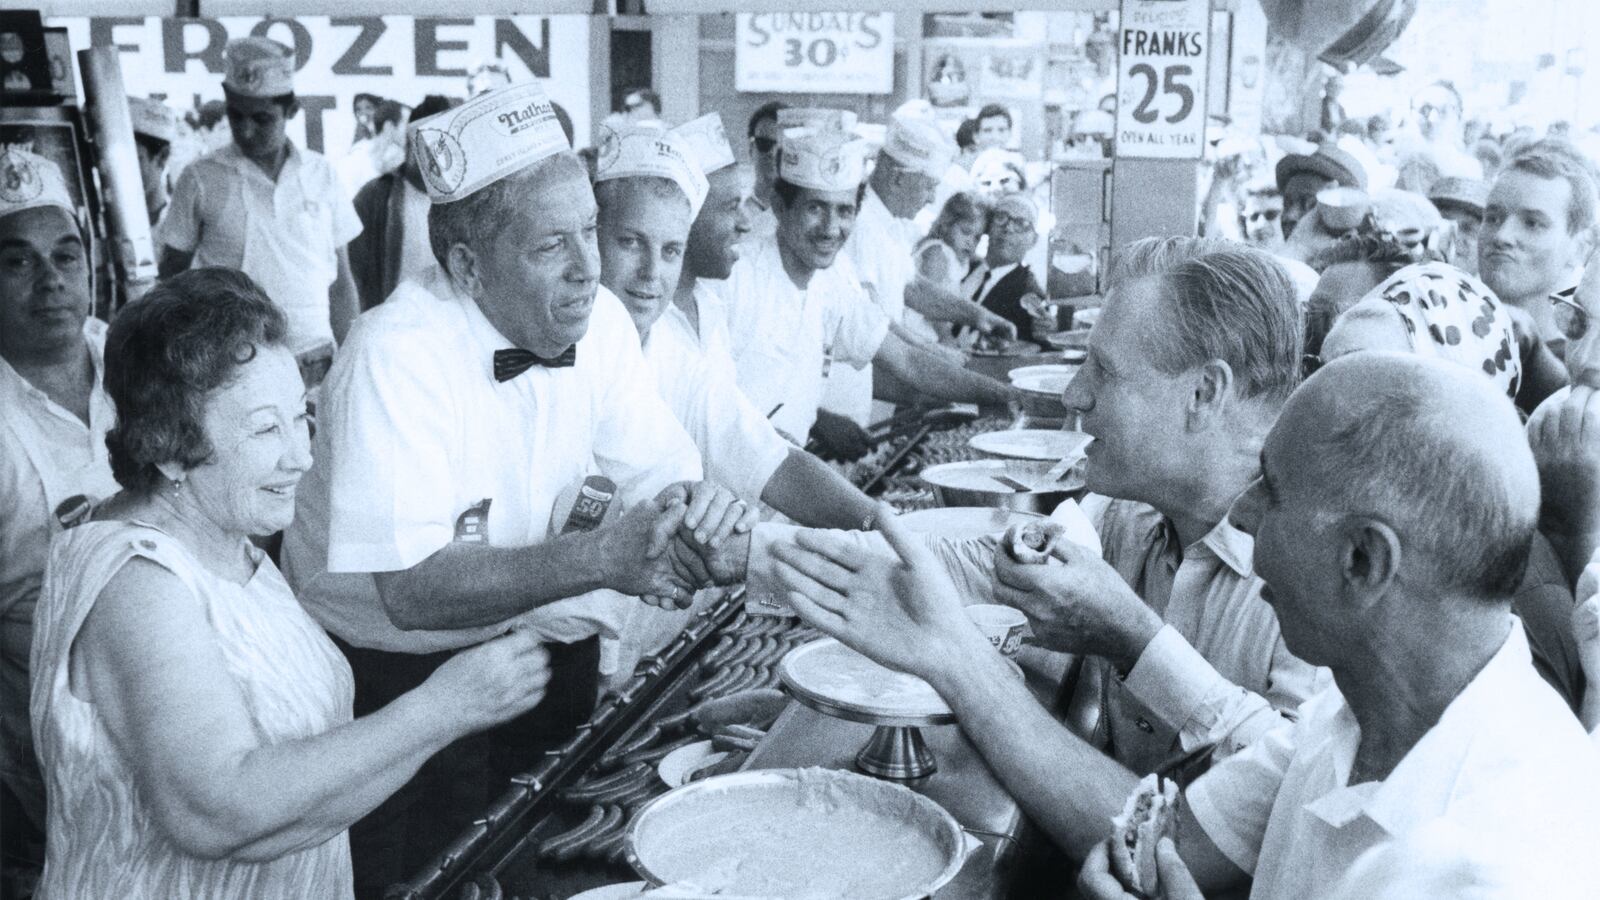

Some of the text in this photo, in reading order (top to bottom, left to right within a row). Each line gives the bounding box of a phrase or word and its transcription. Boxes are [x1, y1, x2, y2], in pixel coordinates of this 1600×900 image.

[89, 17, 552, 78] FROZEN
[1123, 29, 1203, 57] FRANKS
[1128, 63, 1195, 124] 25
[1121, 130, 1197, 146] OPEN ALL YEAR
